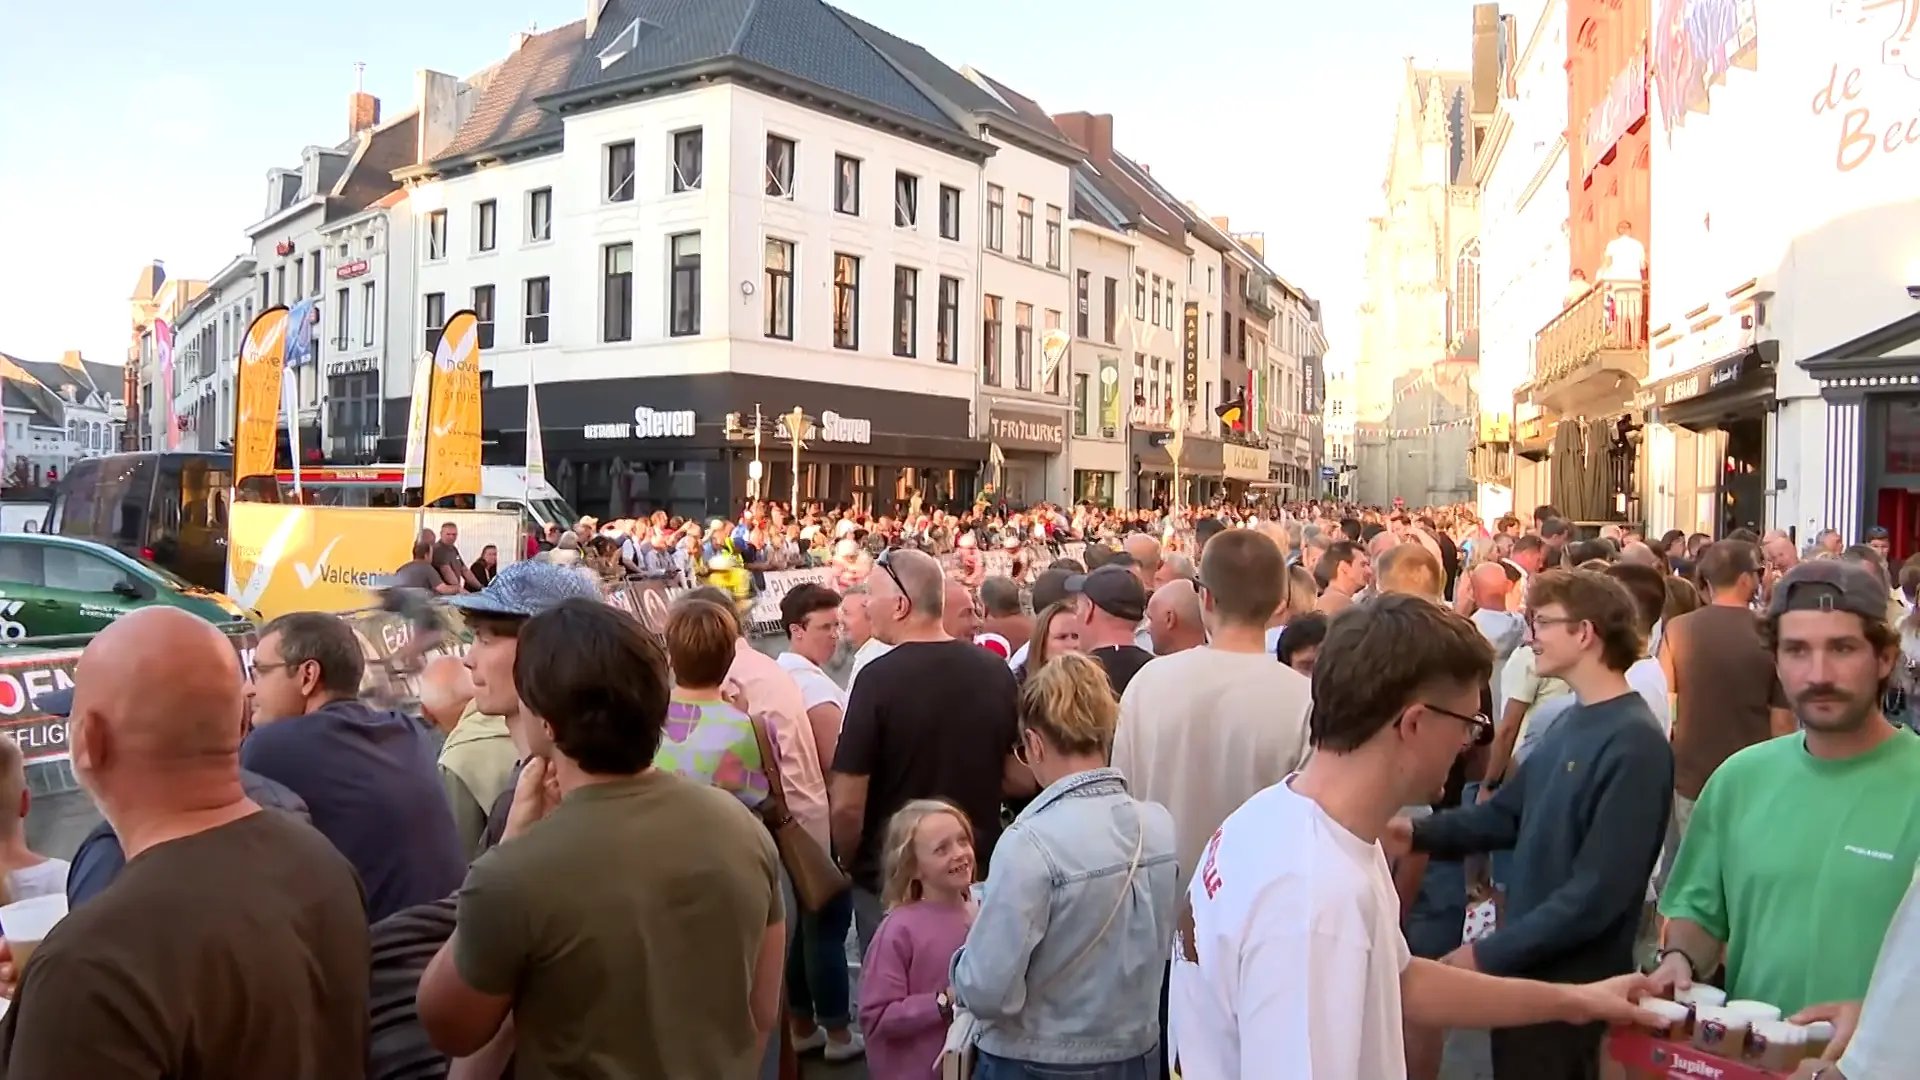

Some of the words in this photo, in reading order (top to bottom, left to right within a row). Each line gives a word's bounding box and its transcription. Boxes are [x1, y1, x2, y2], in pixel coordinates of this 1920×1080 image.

[1811, 62, 1862, 115] de
[635, 406, 696, 438] Steven
[822, 410, 871, 444] Steven
[1000, 419, 1062, 443] FRITUURKE
[1669, 1053, 1724, 1080] Jupiler
